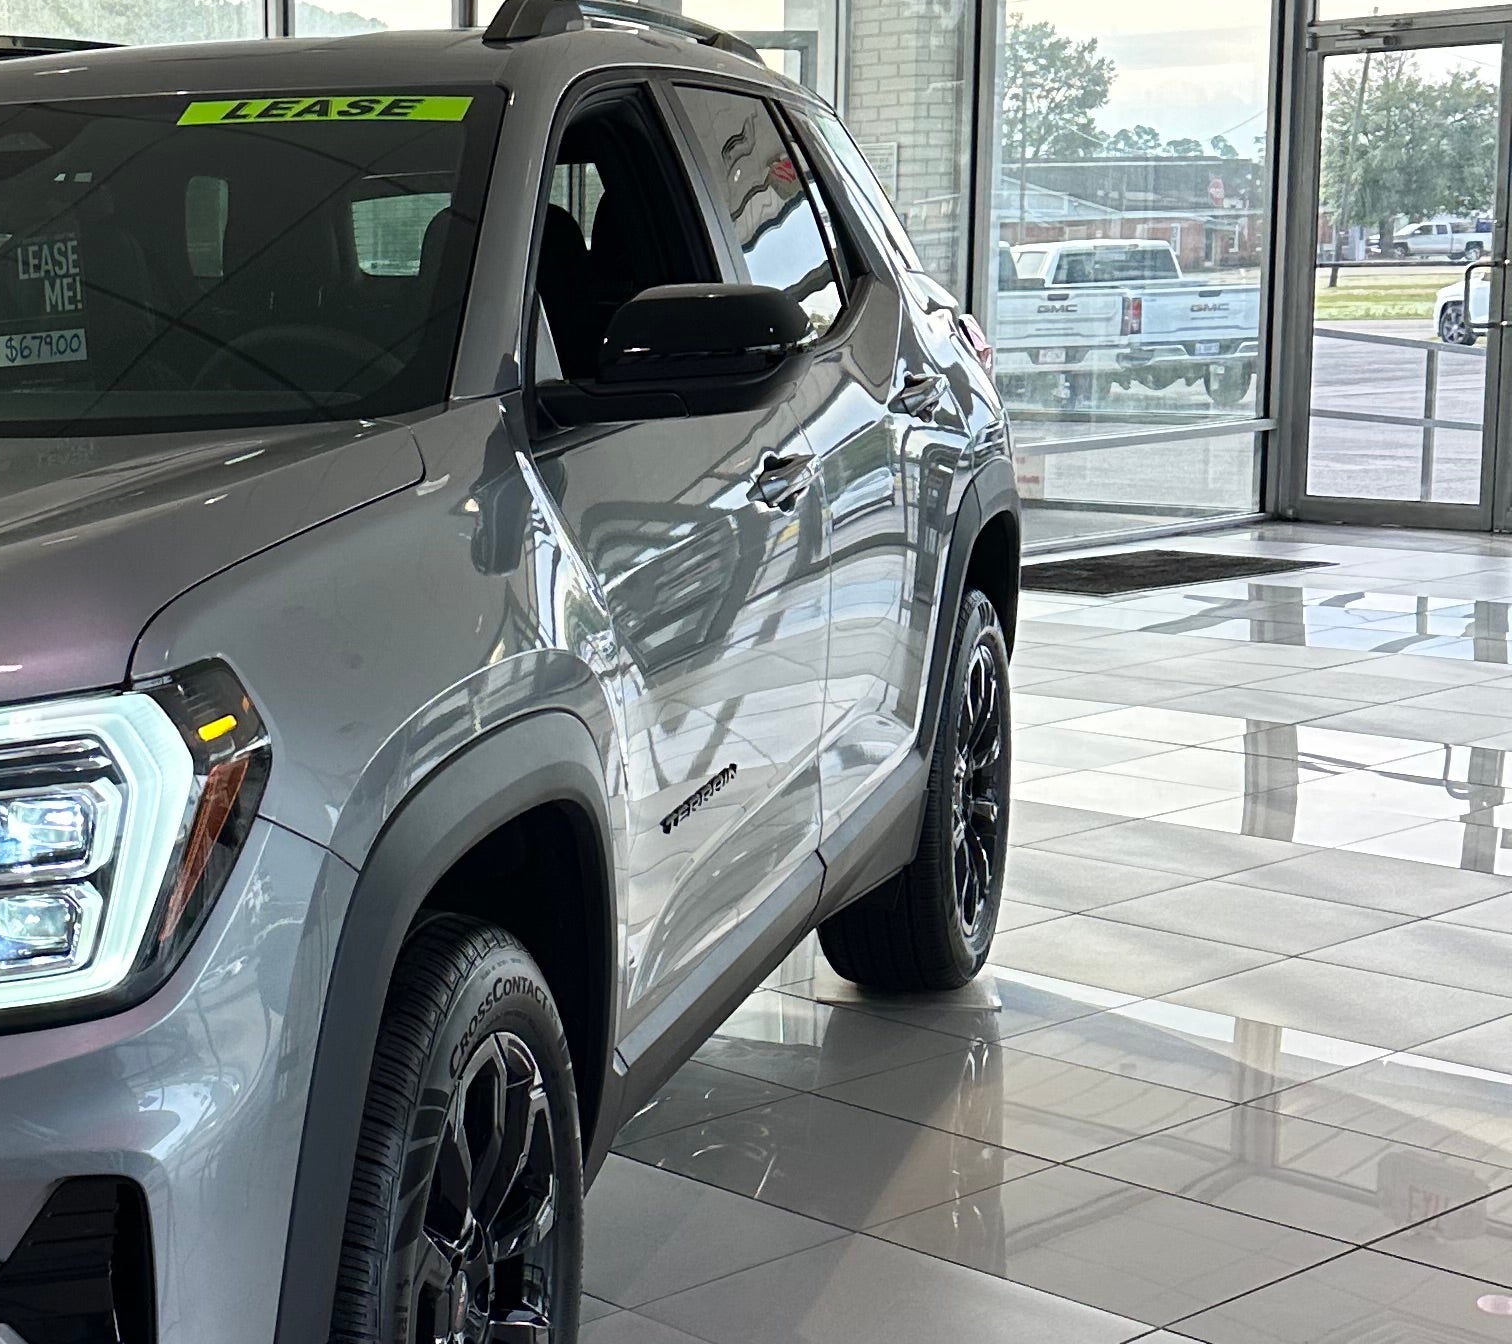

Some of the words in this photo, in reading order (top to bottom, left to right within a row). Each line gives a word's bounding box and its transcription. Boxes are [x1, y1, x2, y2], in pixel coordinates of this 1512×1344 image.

[220, 98, 425, 121] LEASE
[17, 240, 80, 280] LEASE
[44, 276, 83, 313] ME!
[1189, 302, 1230, 313] GMC
[1037, 303, 1079, 314] GMC
[4, 333, 82, 363] $679.00
